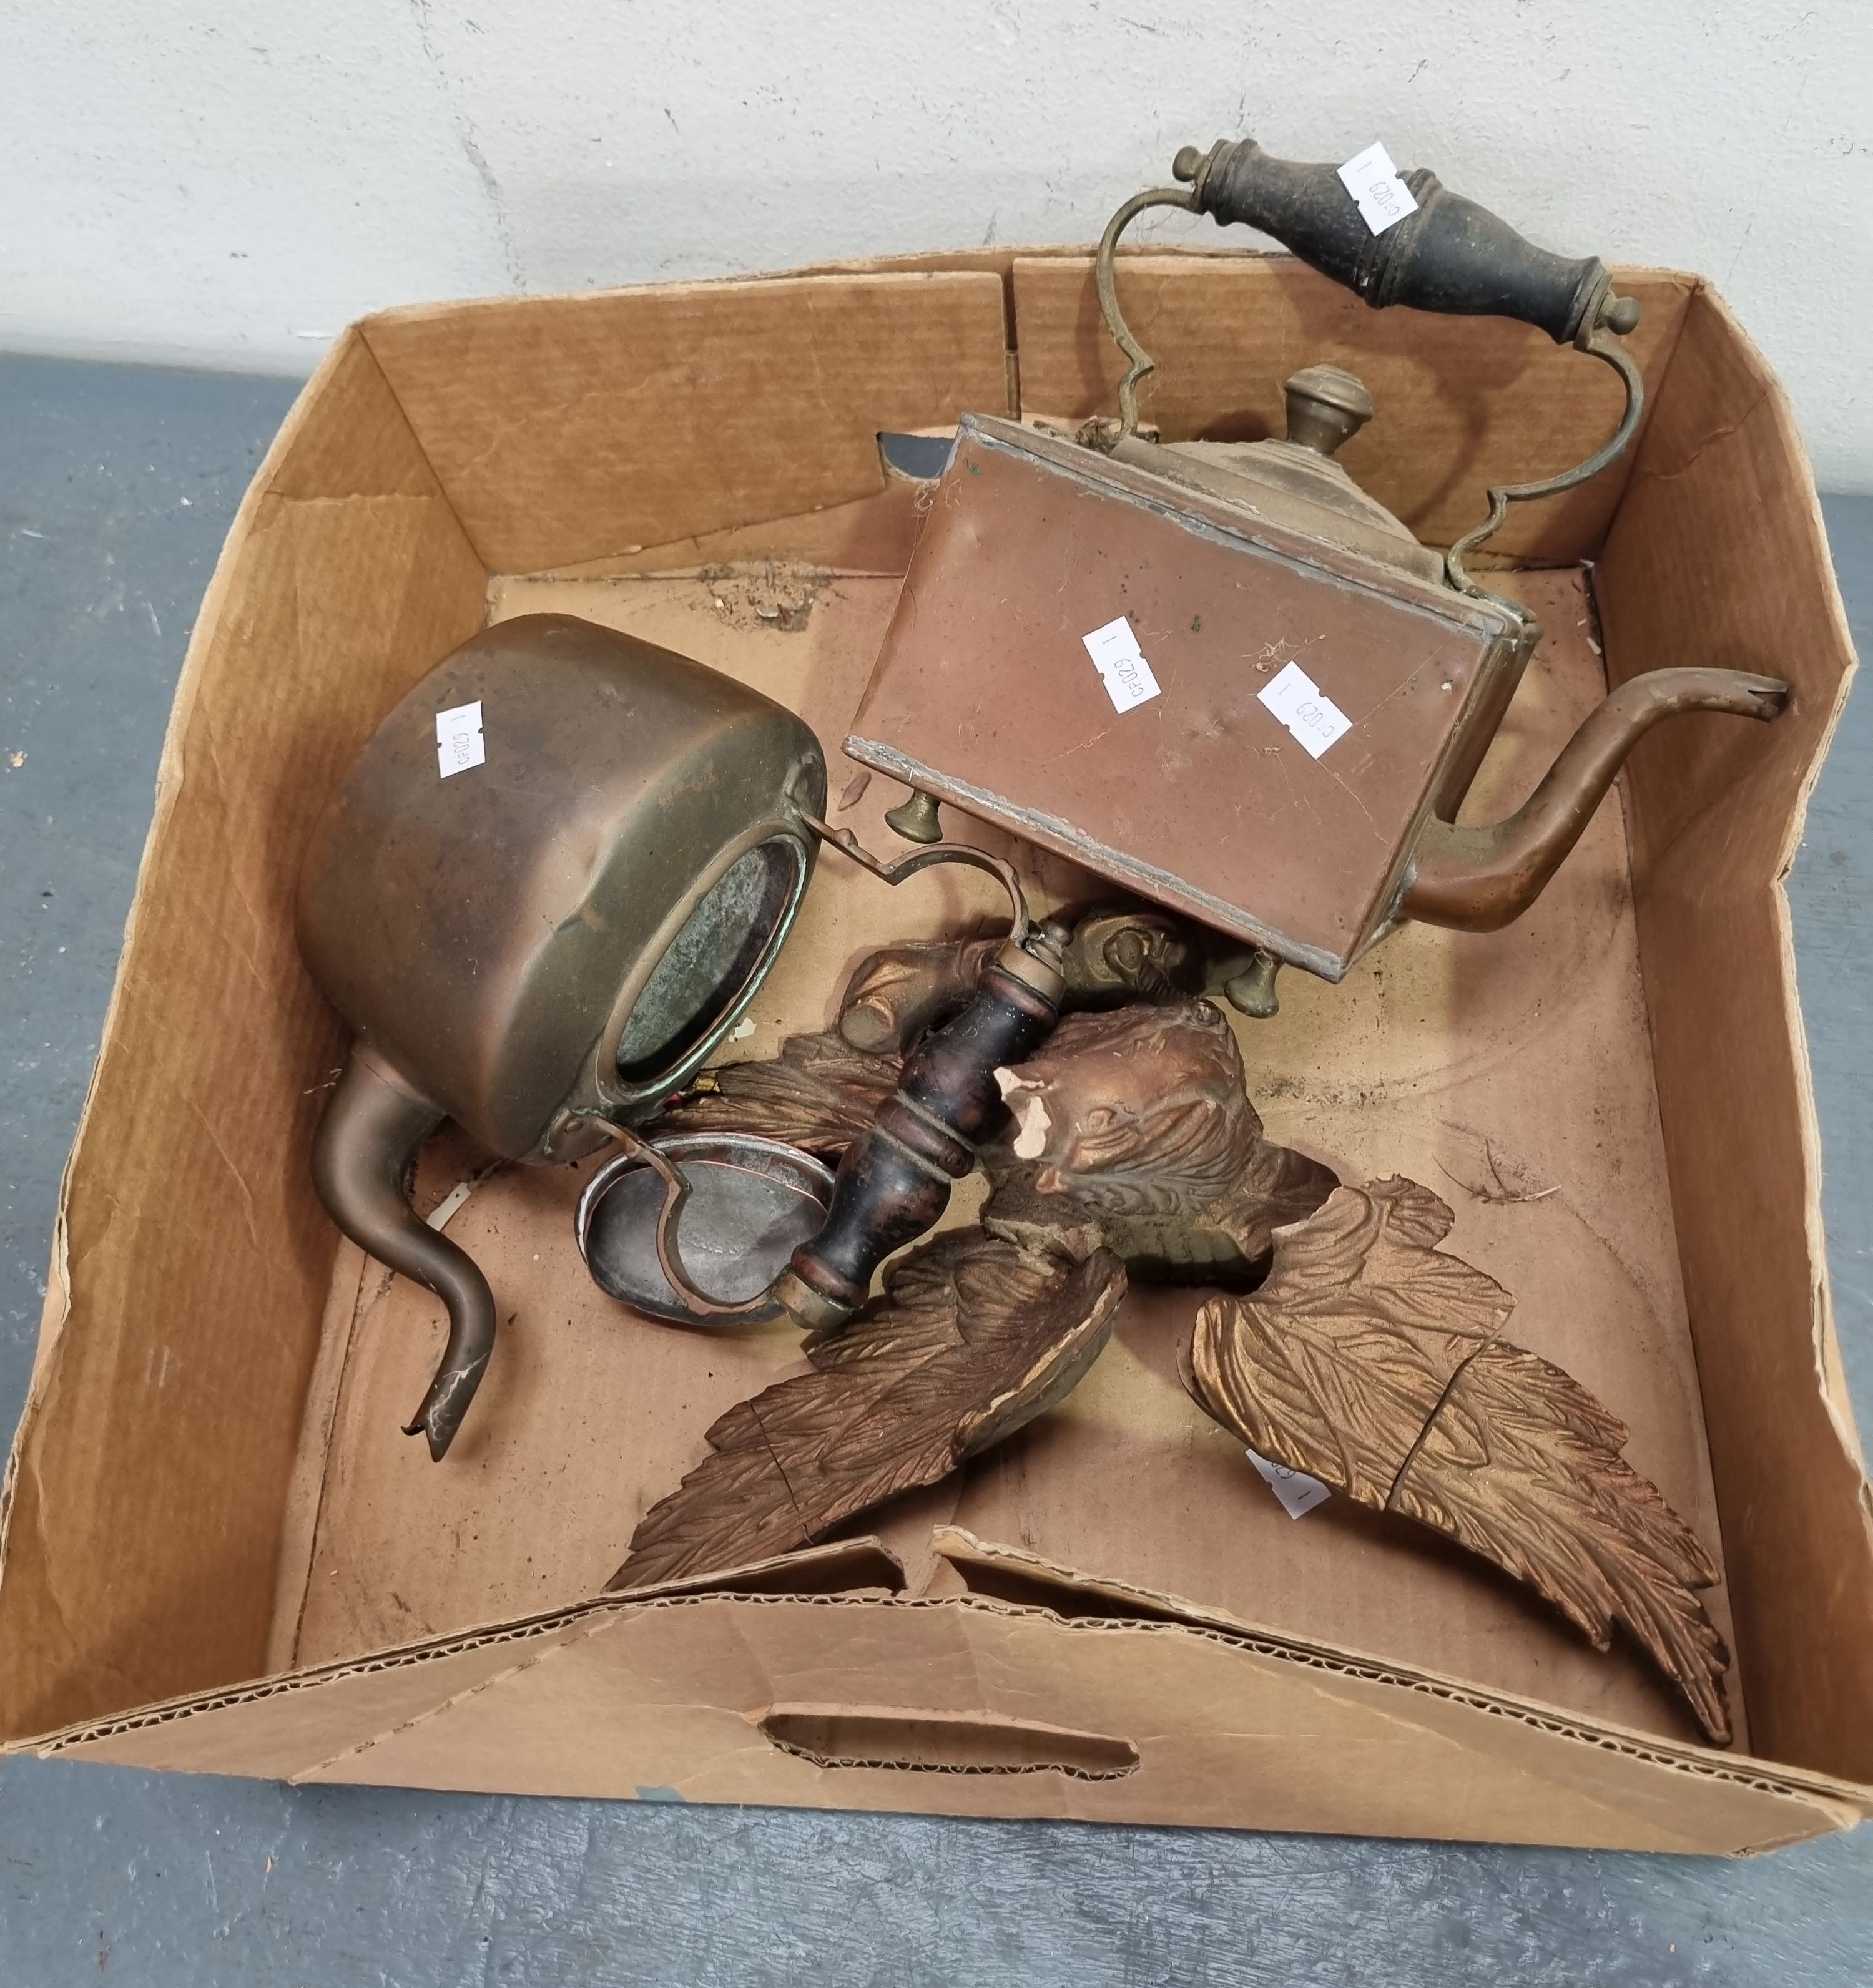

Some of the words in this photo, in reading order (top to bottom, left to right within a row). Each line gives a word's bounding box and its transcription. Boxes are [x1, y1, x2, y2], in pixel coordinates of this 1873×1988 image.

[1357, 162, 1372, 172] 1
[1103, 635, 1117, 644] 1
[1279, 683, 1291, 695] 1
[1298, 1490, 1311, 1500] 1
